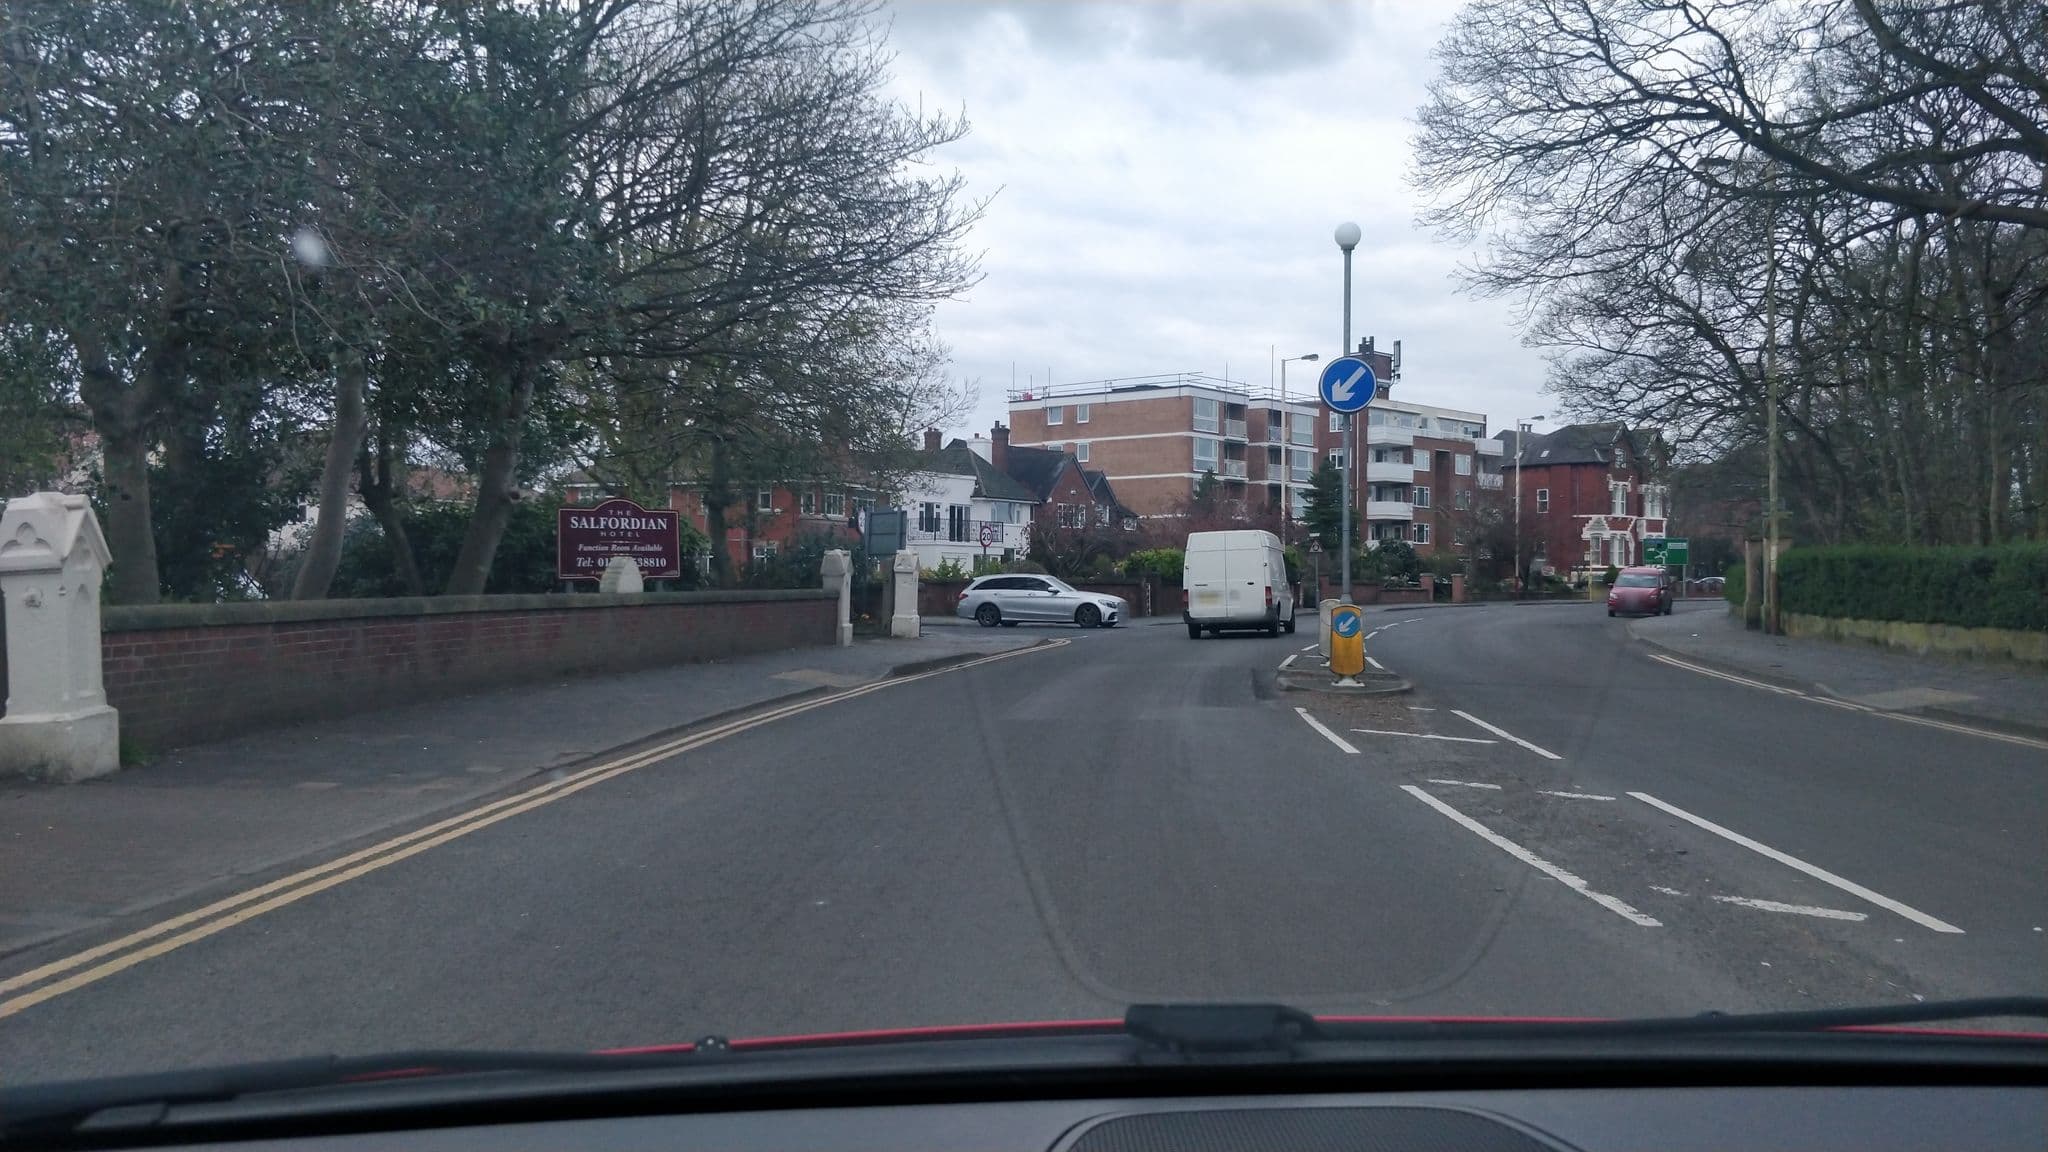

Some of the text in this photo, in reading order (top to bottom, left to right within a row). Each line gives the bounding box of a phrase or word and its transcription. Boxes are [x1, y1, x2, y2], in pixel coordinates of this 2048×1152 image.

[570, 516, 668, 530] SALFORDIAN
[983, 532, 991, 541] 20
[578, 544, 663, 552] Function Room Available
[576, 557, 594, 567] Tel:
